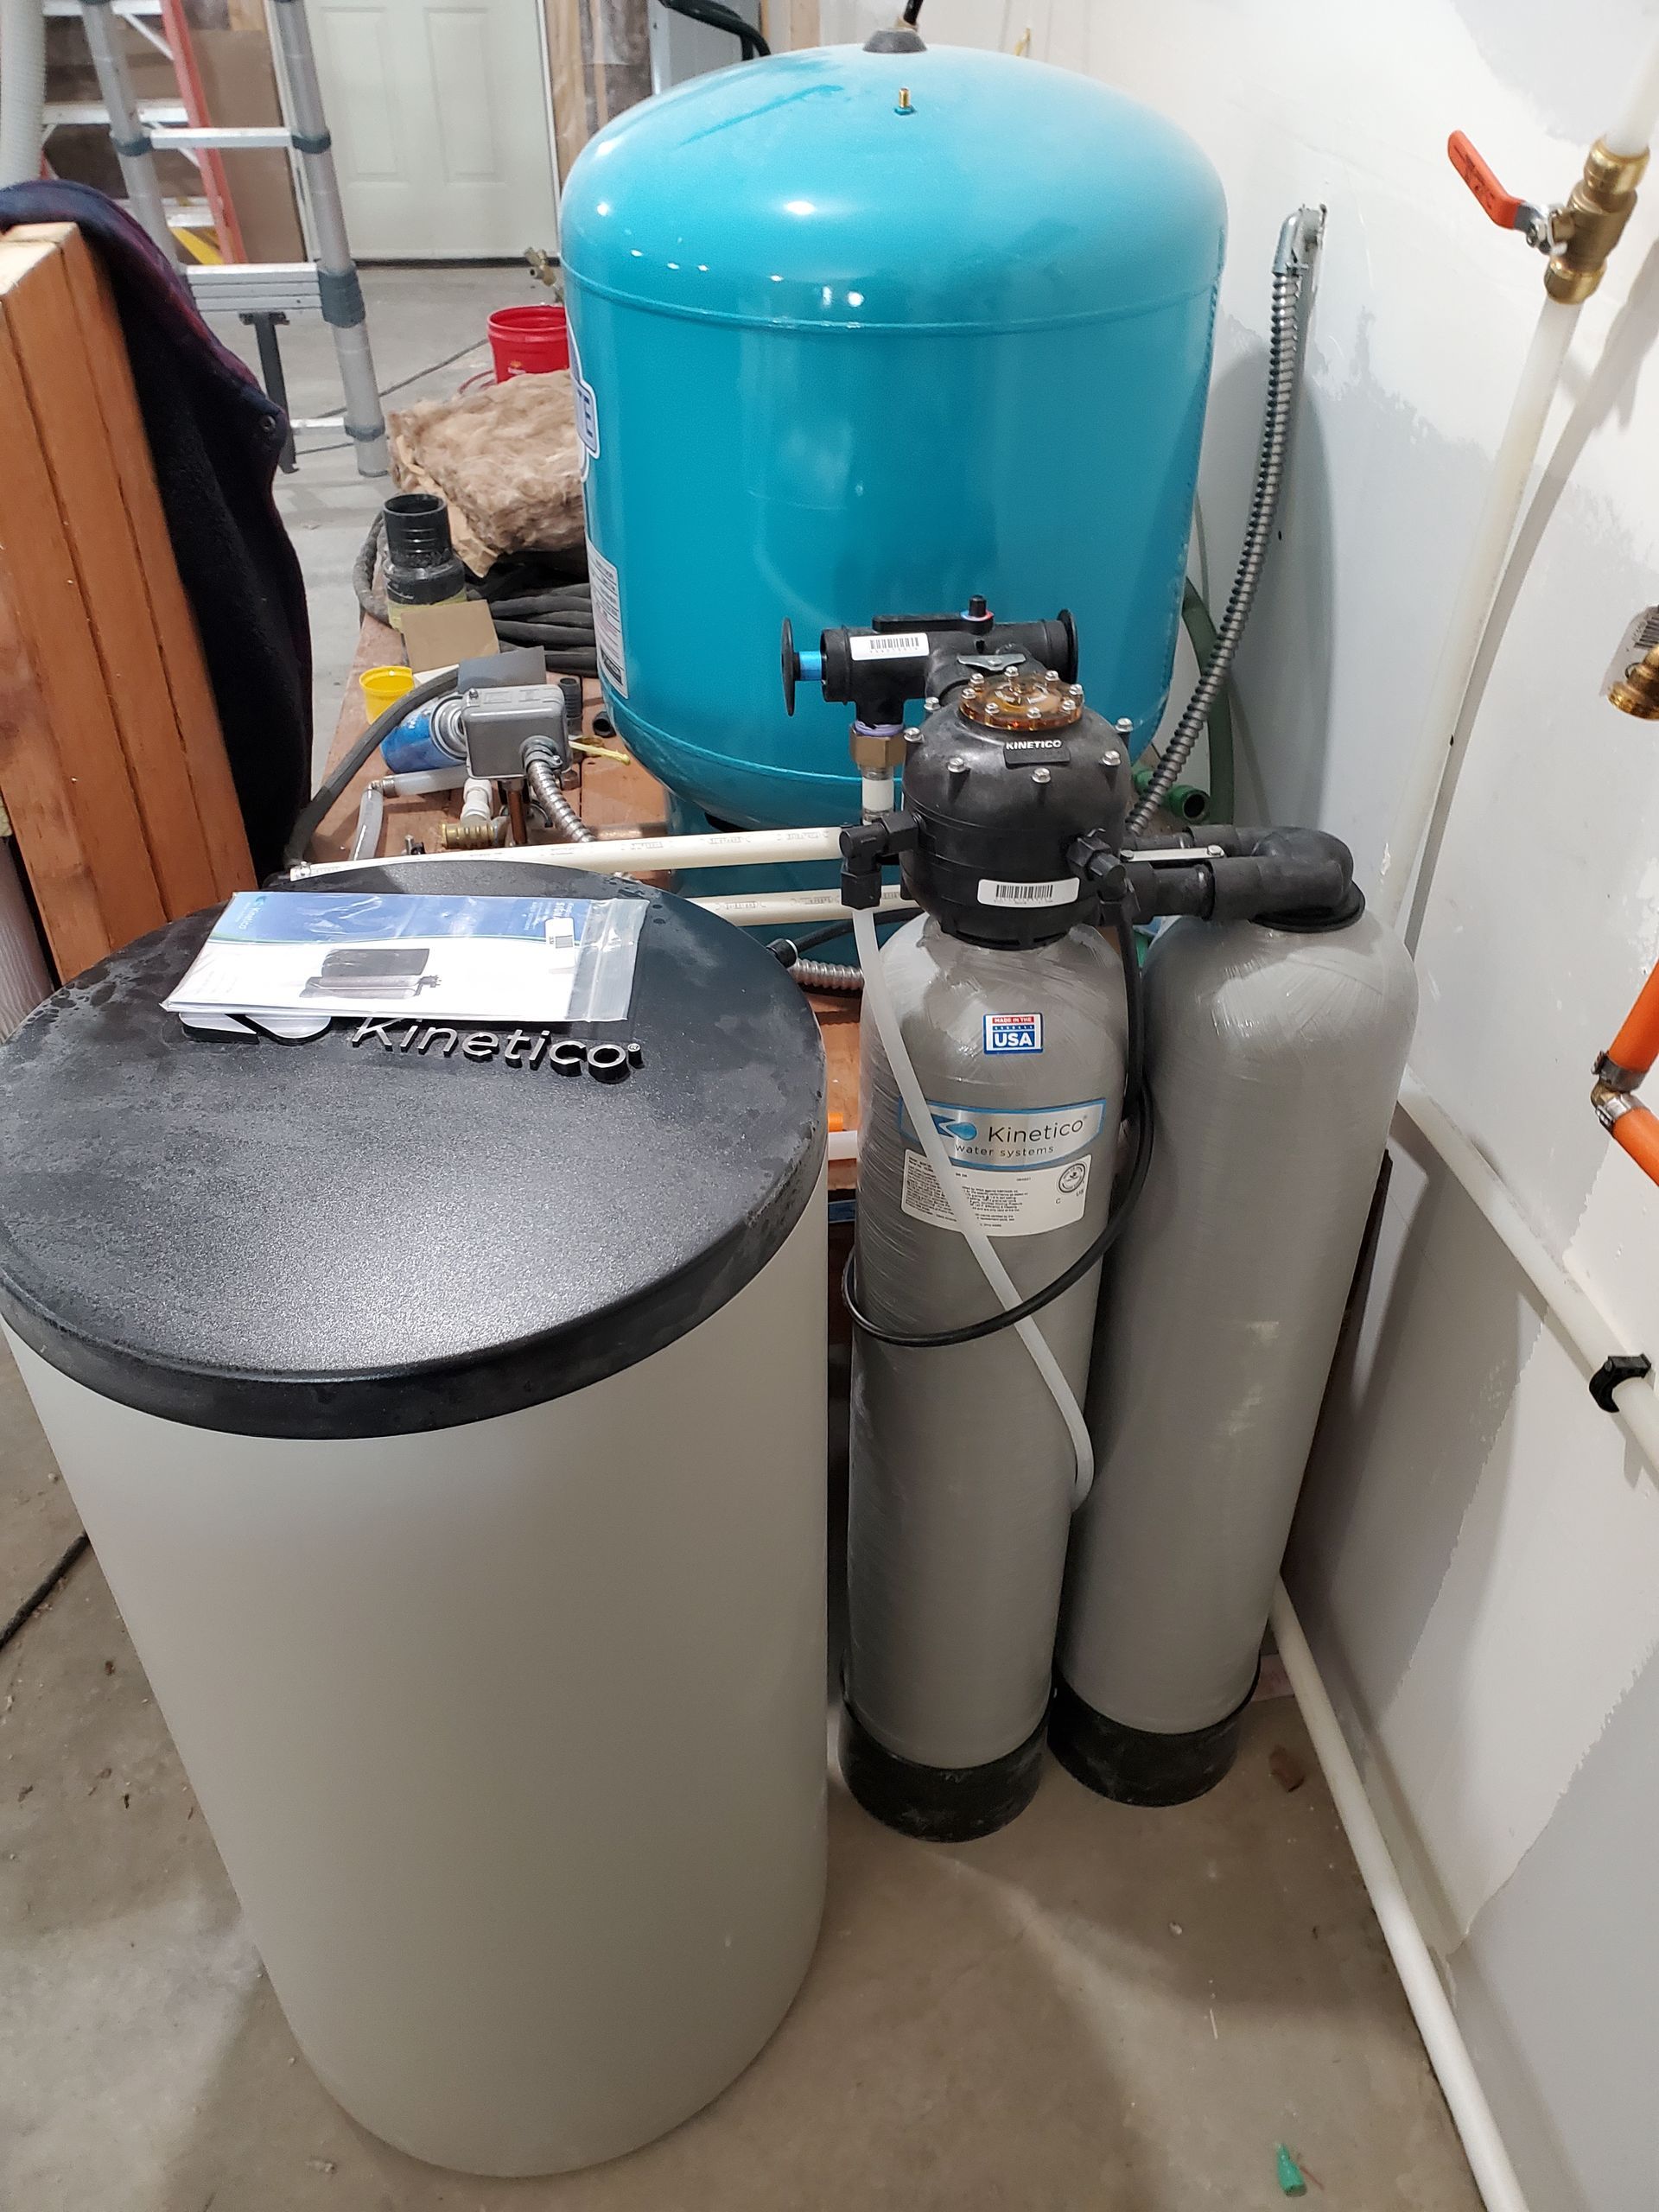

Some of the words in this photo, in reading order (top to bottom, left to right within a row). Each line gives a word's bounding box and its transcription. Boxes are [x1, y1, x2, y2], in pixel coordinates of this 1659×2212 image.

[1005, 739, 1062, 750] KINETICO
[994, 1032, 1033, 1047] USA
[988, 1119, 1084, 1143] Kinetico
[955, 1143, 994, 1156] water
[1000, 1146, 1054, 1158] systems
